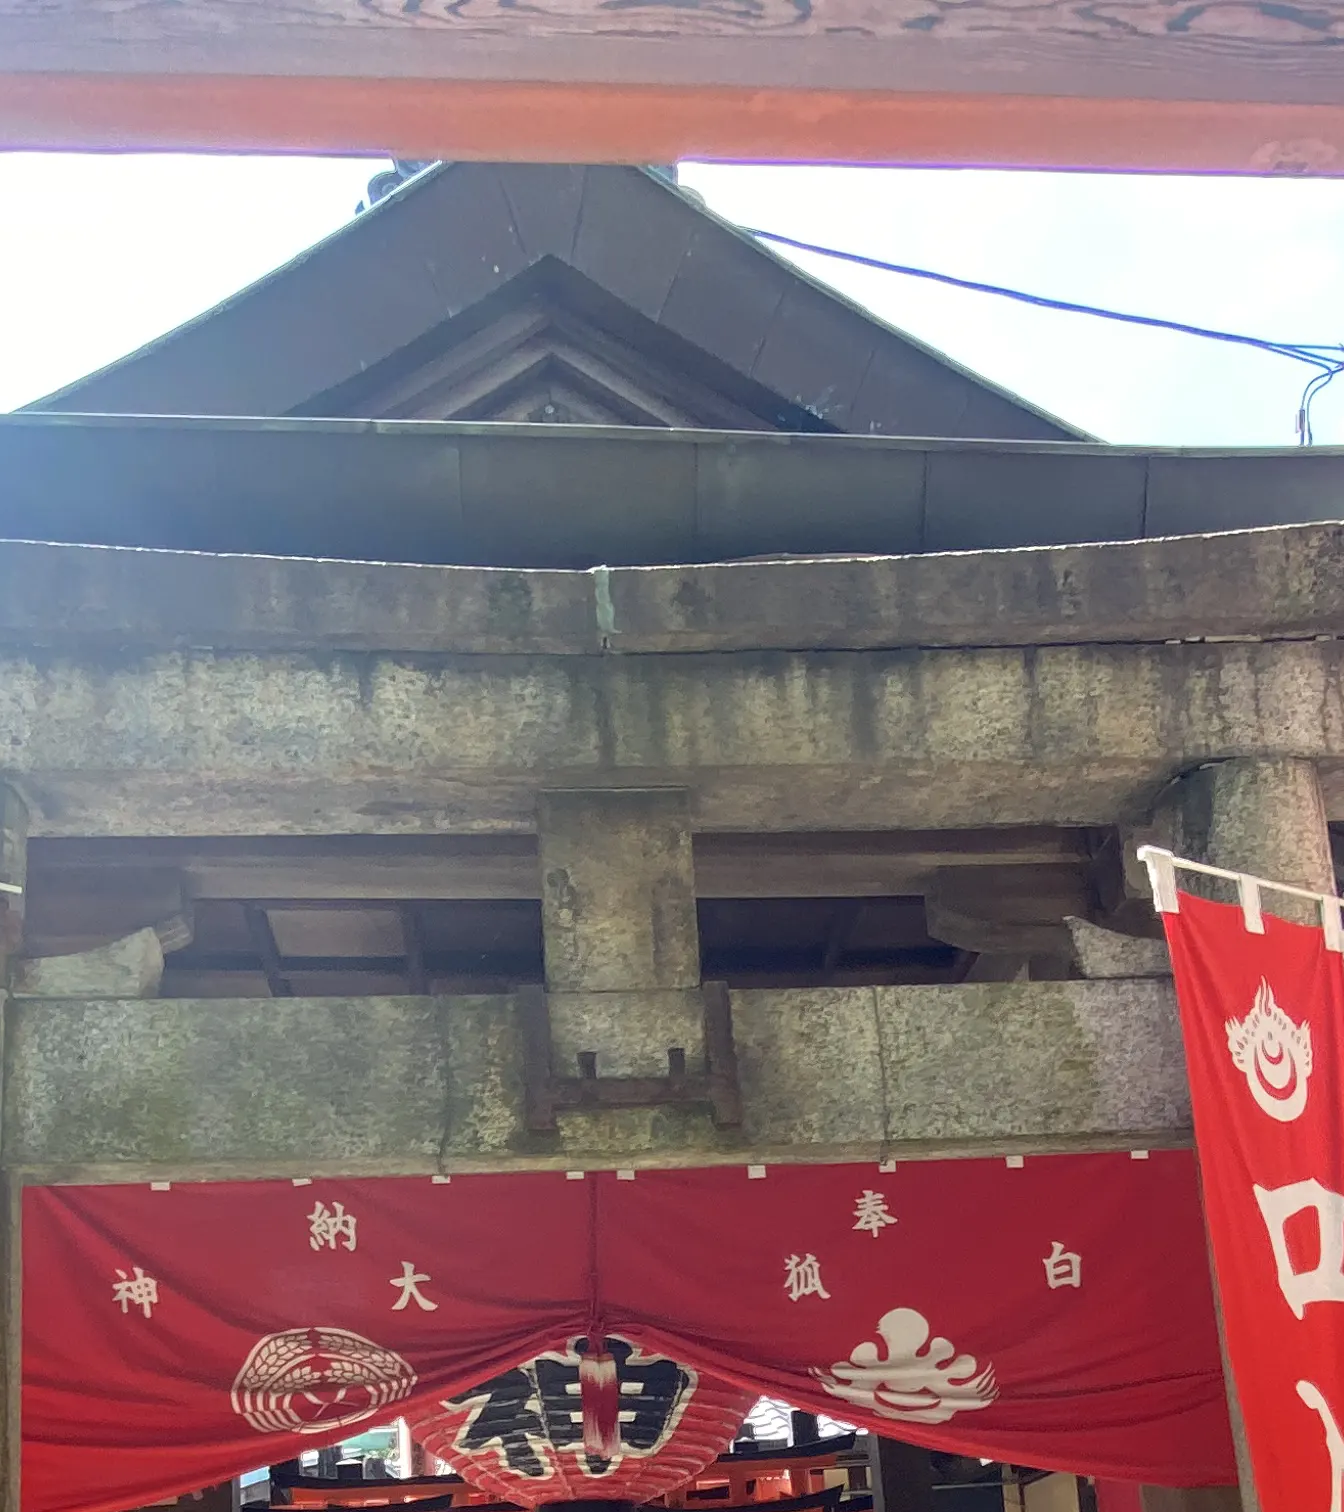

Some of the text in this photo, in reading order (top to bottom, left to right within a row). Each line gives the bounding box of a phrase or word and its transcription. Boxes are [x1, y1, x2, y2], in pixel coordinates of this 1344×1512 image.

[307, 1190, 898, 1252] 奉 納
[112, 1241, 1082, 1319] 白 狐 大 神
